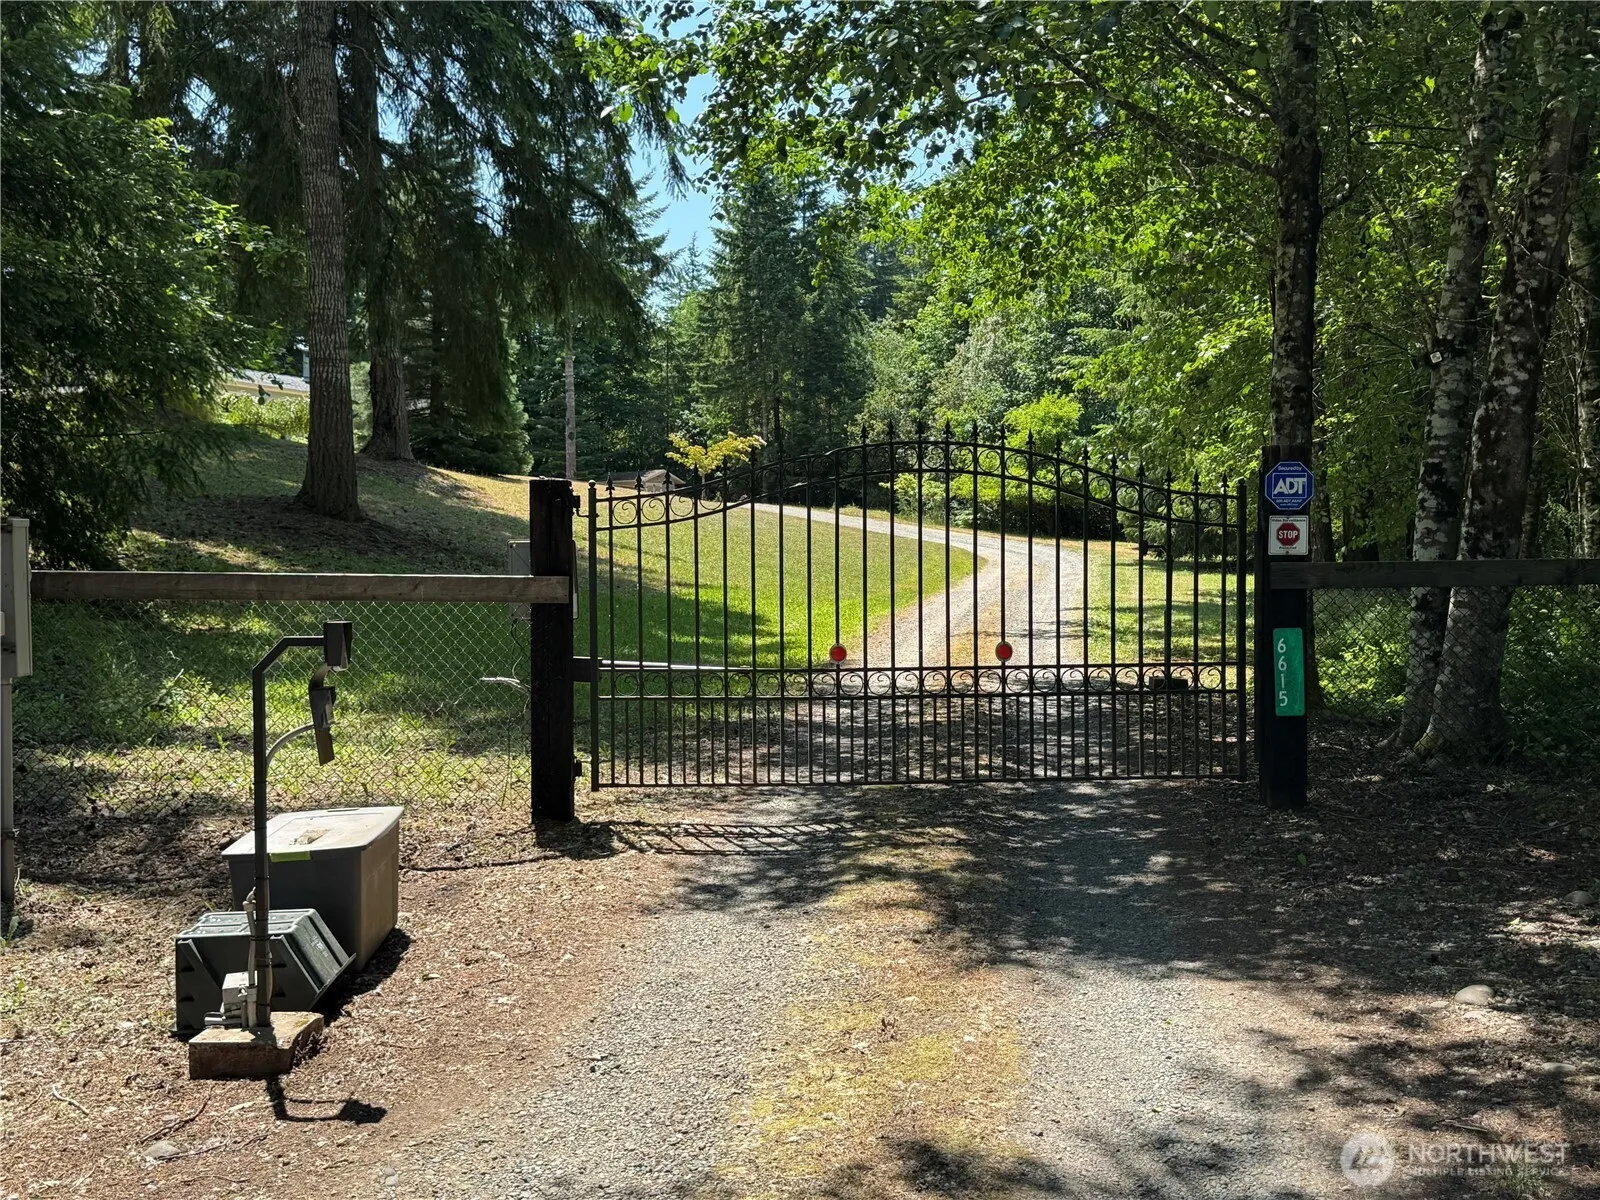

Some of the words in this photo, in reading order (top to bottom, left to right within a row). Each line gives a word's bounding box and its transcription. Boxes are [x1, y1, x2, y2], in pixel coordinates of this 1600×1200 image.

[1273, 478, 1306, 494] ADT
[1278, 530, 1298, 539] STOP
[1277, 638, 1288, 707] 6615
